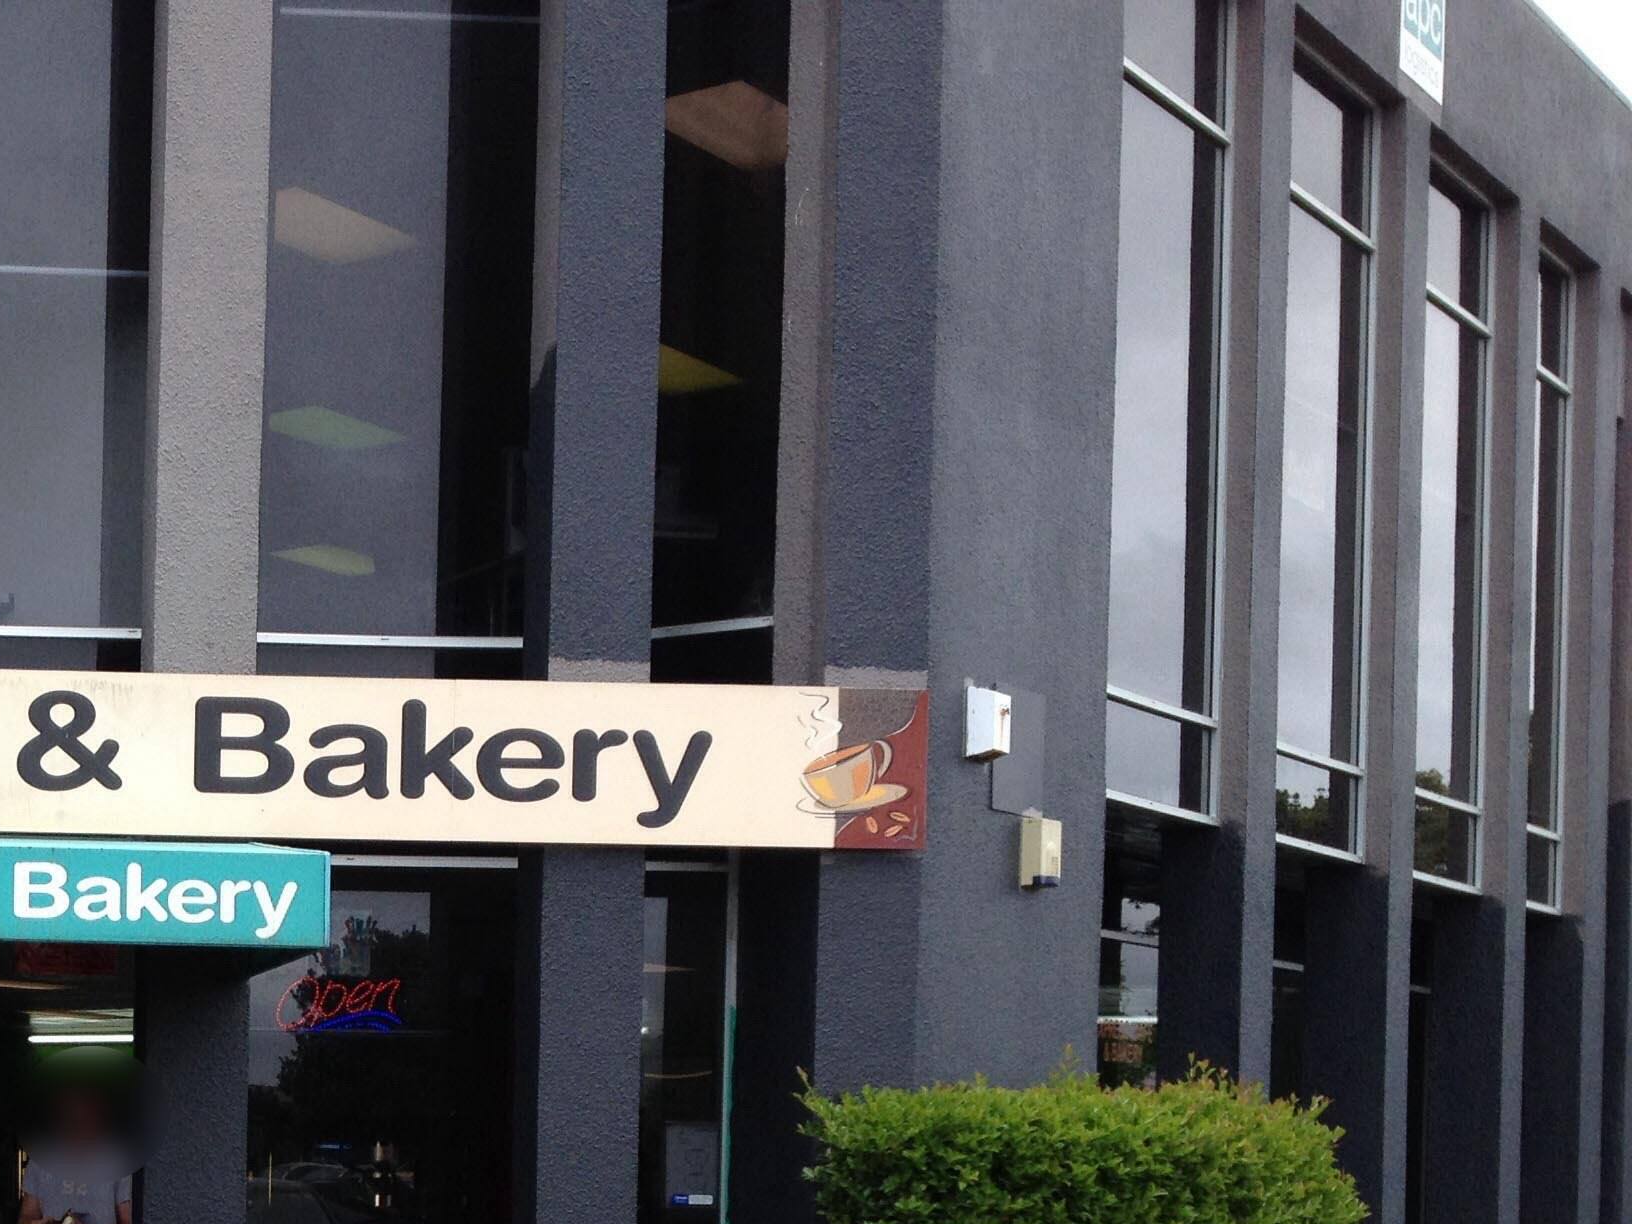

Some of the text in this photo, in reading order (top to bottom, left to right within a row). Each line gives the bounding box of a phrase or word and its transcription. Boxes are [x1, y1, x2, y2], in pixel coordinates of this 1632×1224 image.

[15, 689, 122, 790] &
[193, 696, 712, 827] Bakery
[12, 861, 299, 938] Bakery
[275, 975, 401, 1033] Open
